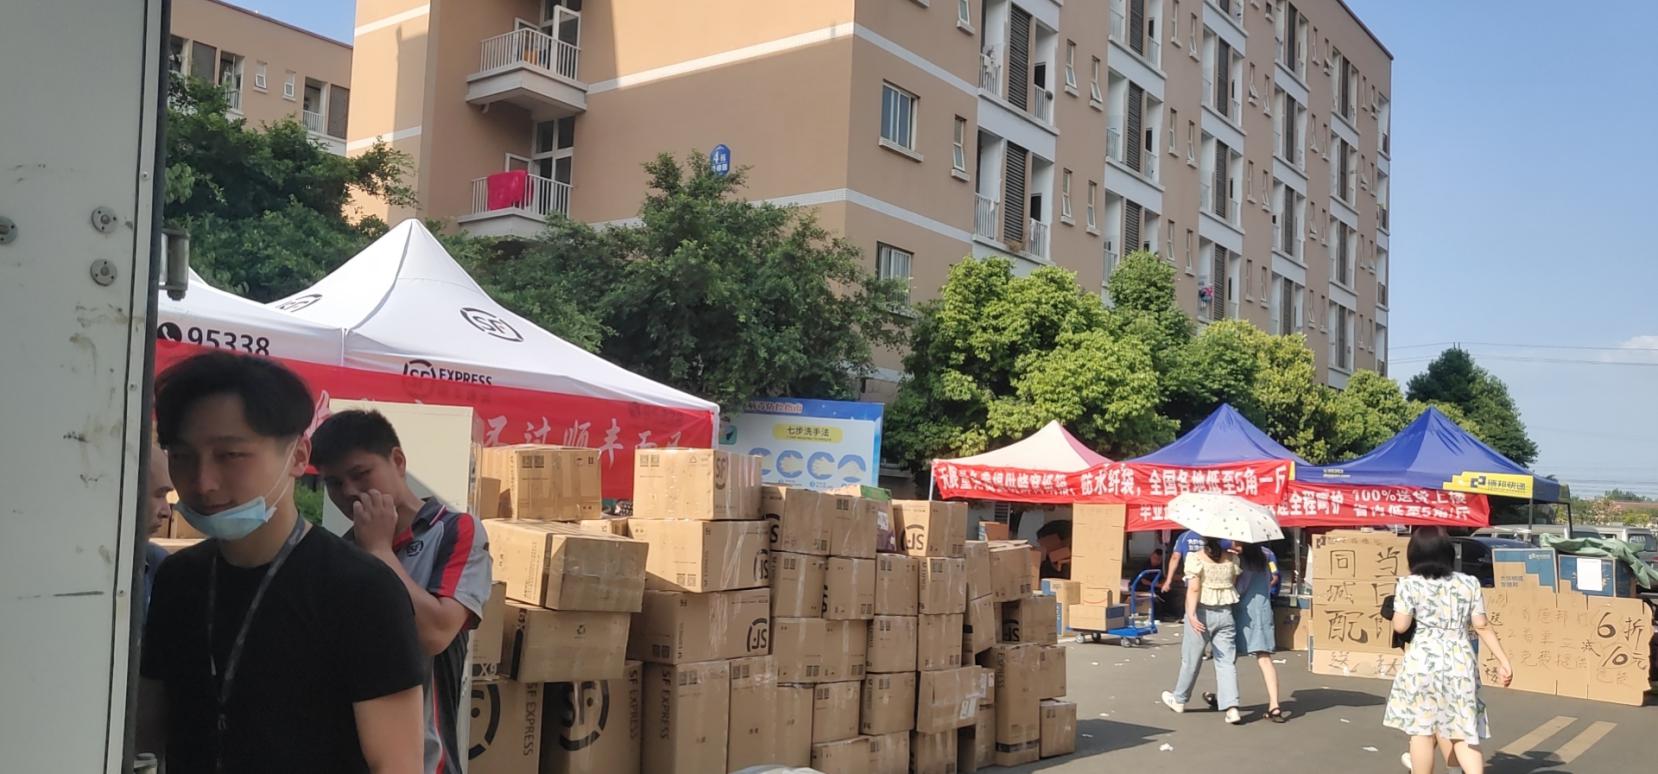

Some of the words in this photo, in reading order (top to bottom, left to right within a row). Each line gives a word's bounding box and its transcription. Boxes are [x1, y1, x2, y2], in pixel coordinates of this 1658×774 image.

[661, 669, 673, 689] SF
[523, 700, 537, 756] EXPRESS
[660, 689, 673, 740] EXPRESS
